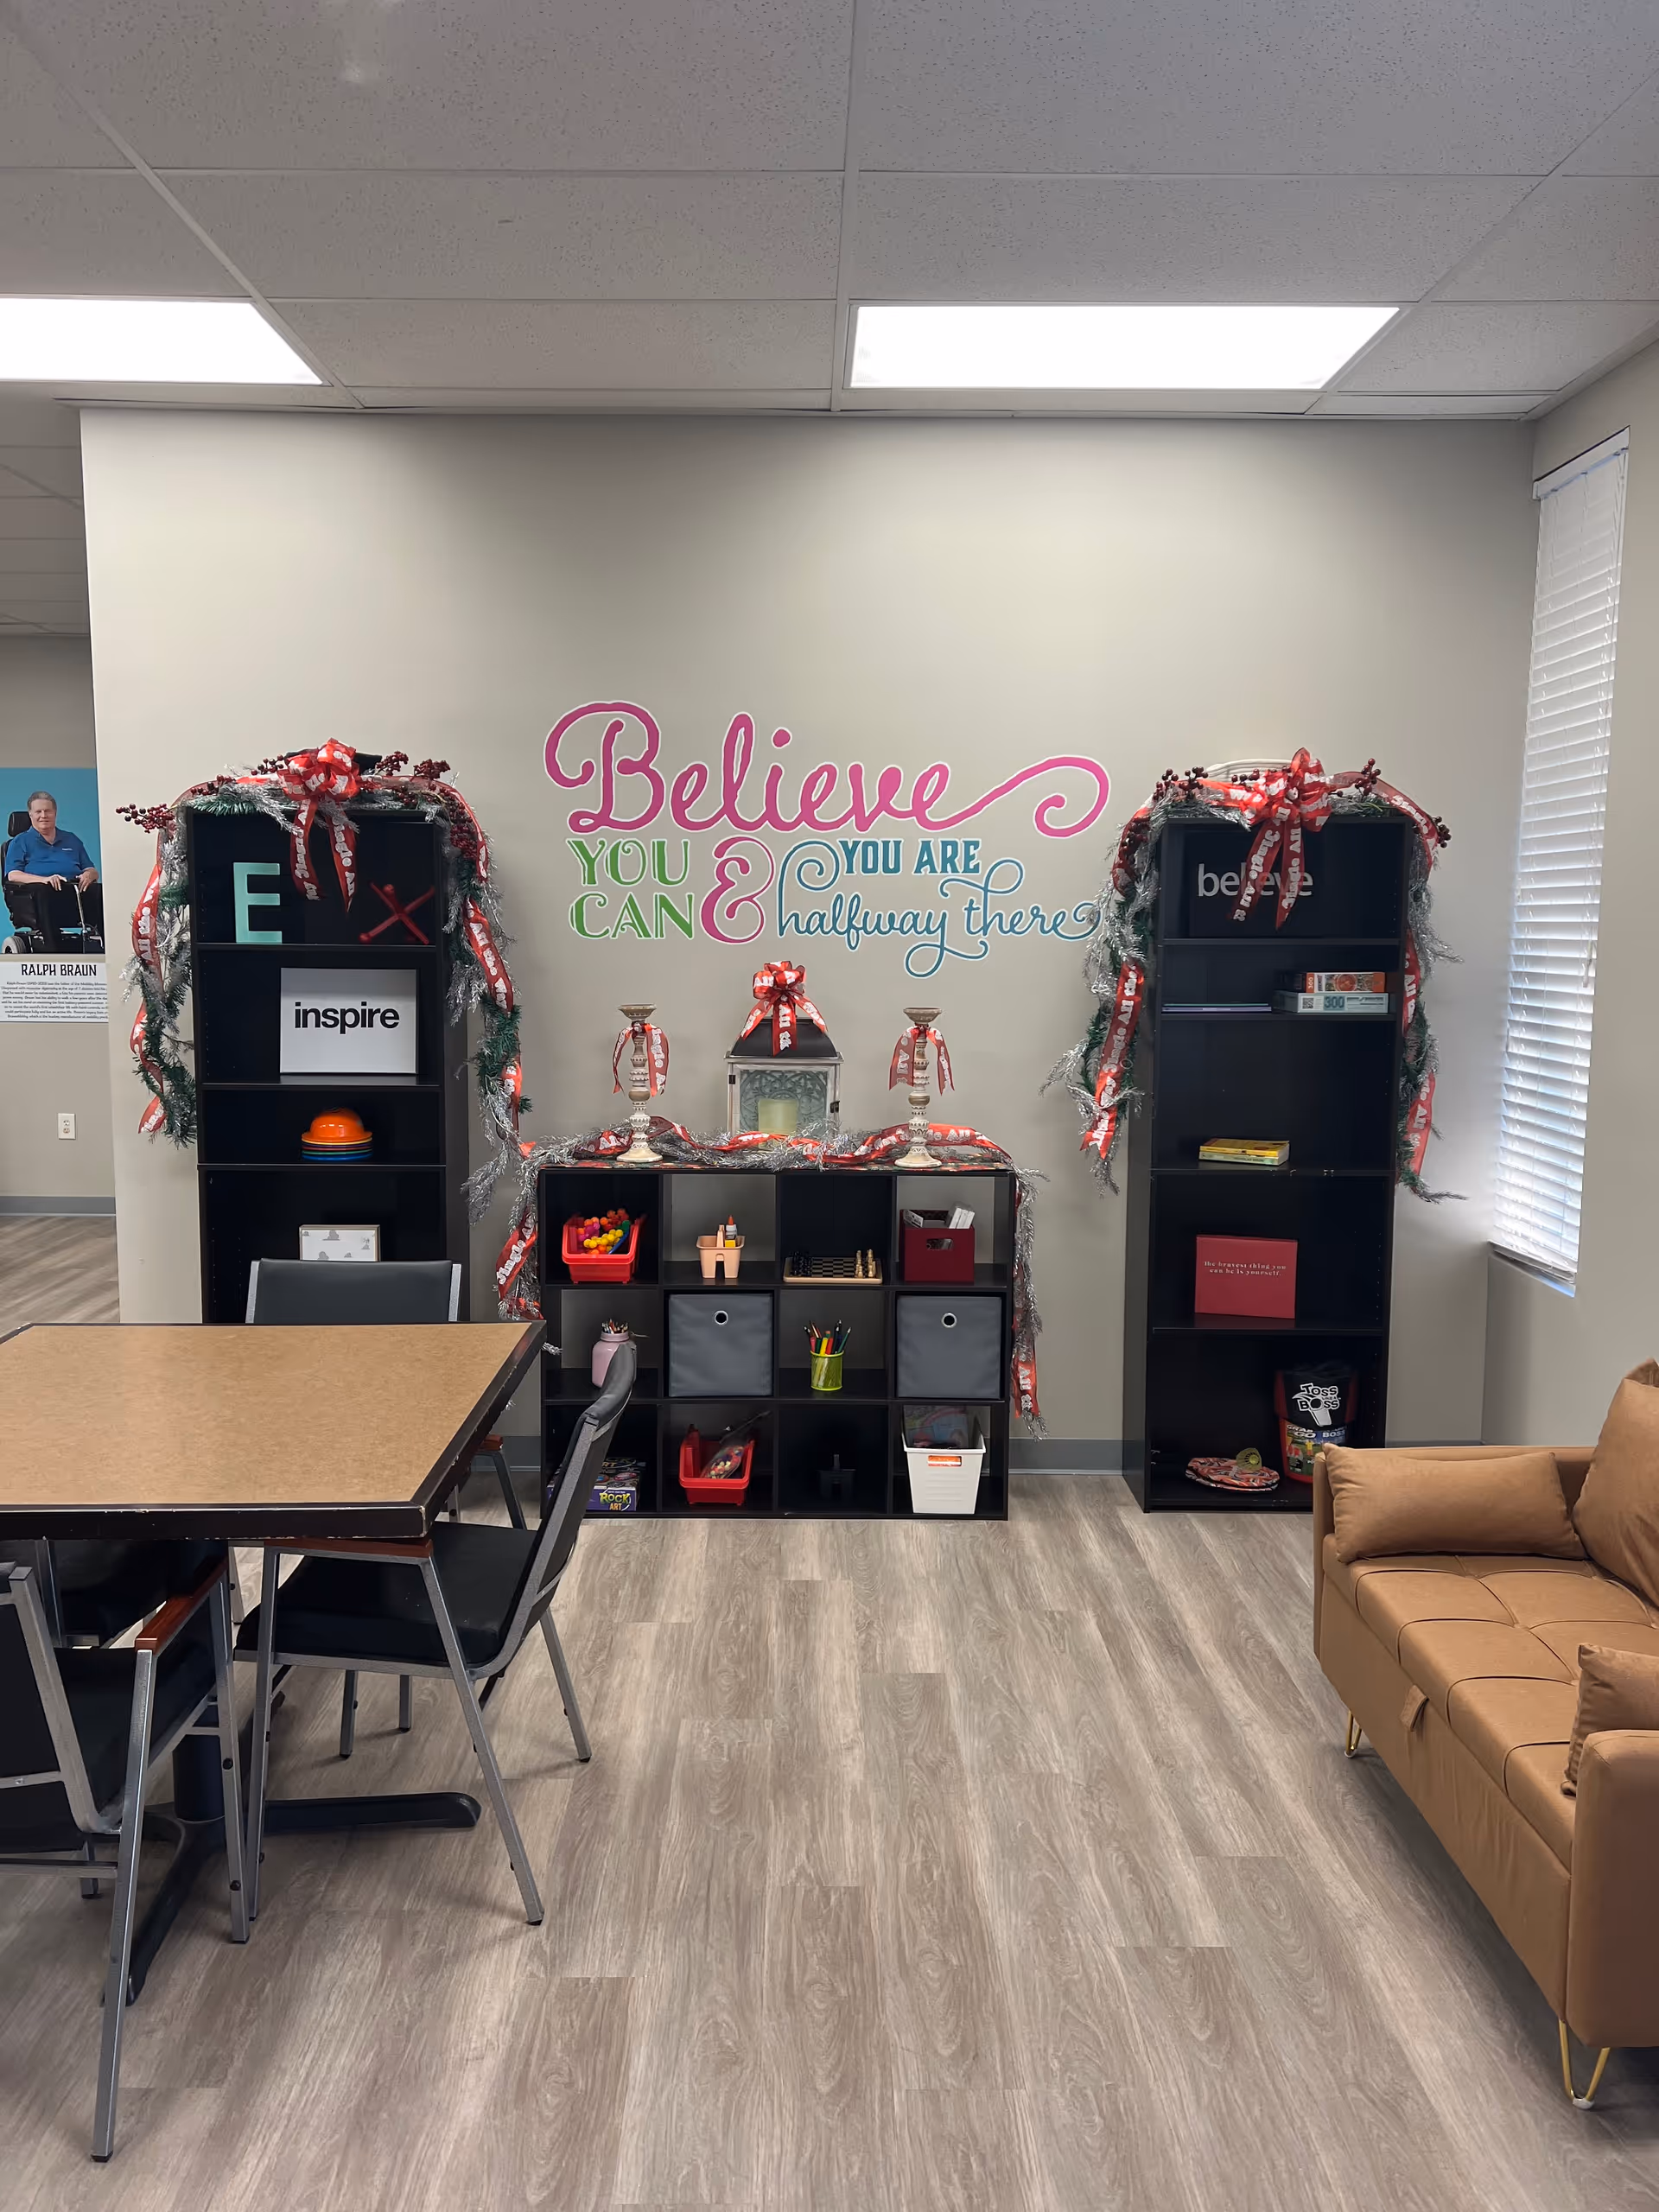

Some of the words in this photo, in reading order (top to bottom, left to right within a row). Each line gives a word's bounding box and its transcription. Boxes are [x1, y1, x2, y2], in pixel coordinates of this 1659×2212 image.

[544, 702, 1109, 837] Believe
[567, 838, 690, 887] YOU
[842, 838, 903, 875] YOU
[912, 838, 981, 875] ARE
[702, 836, 774, 943] &
[1198, 862, 1313, 897] beleve
[232, 861, 283, 944] E
[569, 892, 694, 939] CAN
[779, 840, 989, 978] halfway
[939, 859, 1102, 941] there
[21, 963, 57, 976] RALPH
[60, 964, 97, 976] BRAUN
[294, 1001, 400, 1035] inspire
[1324, 995, 1345, 1008] 300
[1297, 1398, 1340, 1411] BOSS
[1300, 1382, 1338, 1397] TOSS
[599, 1492, 631, 1504] ROCK
